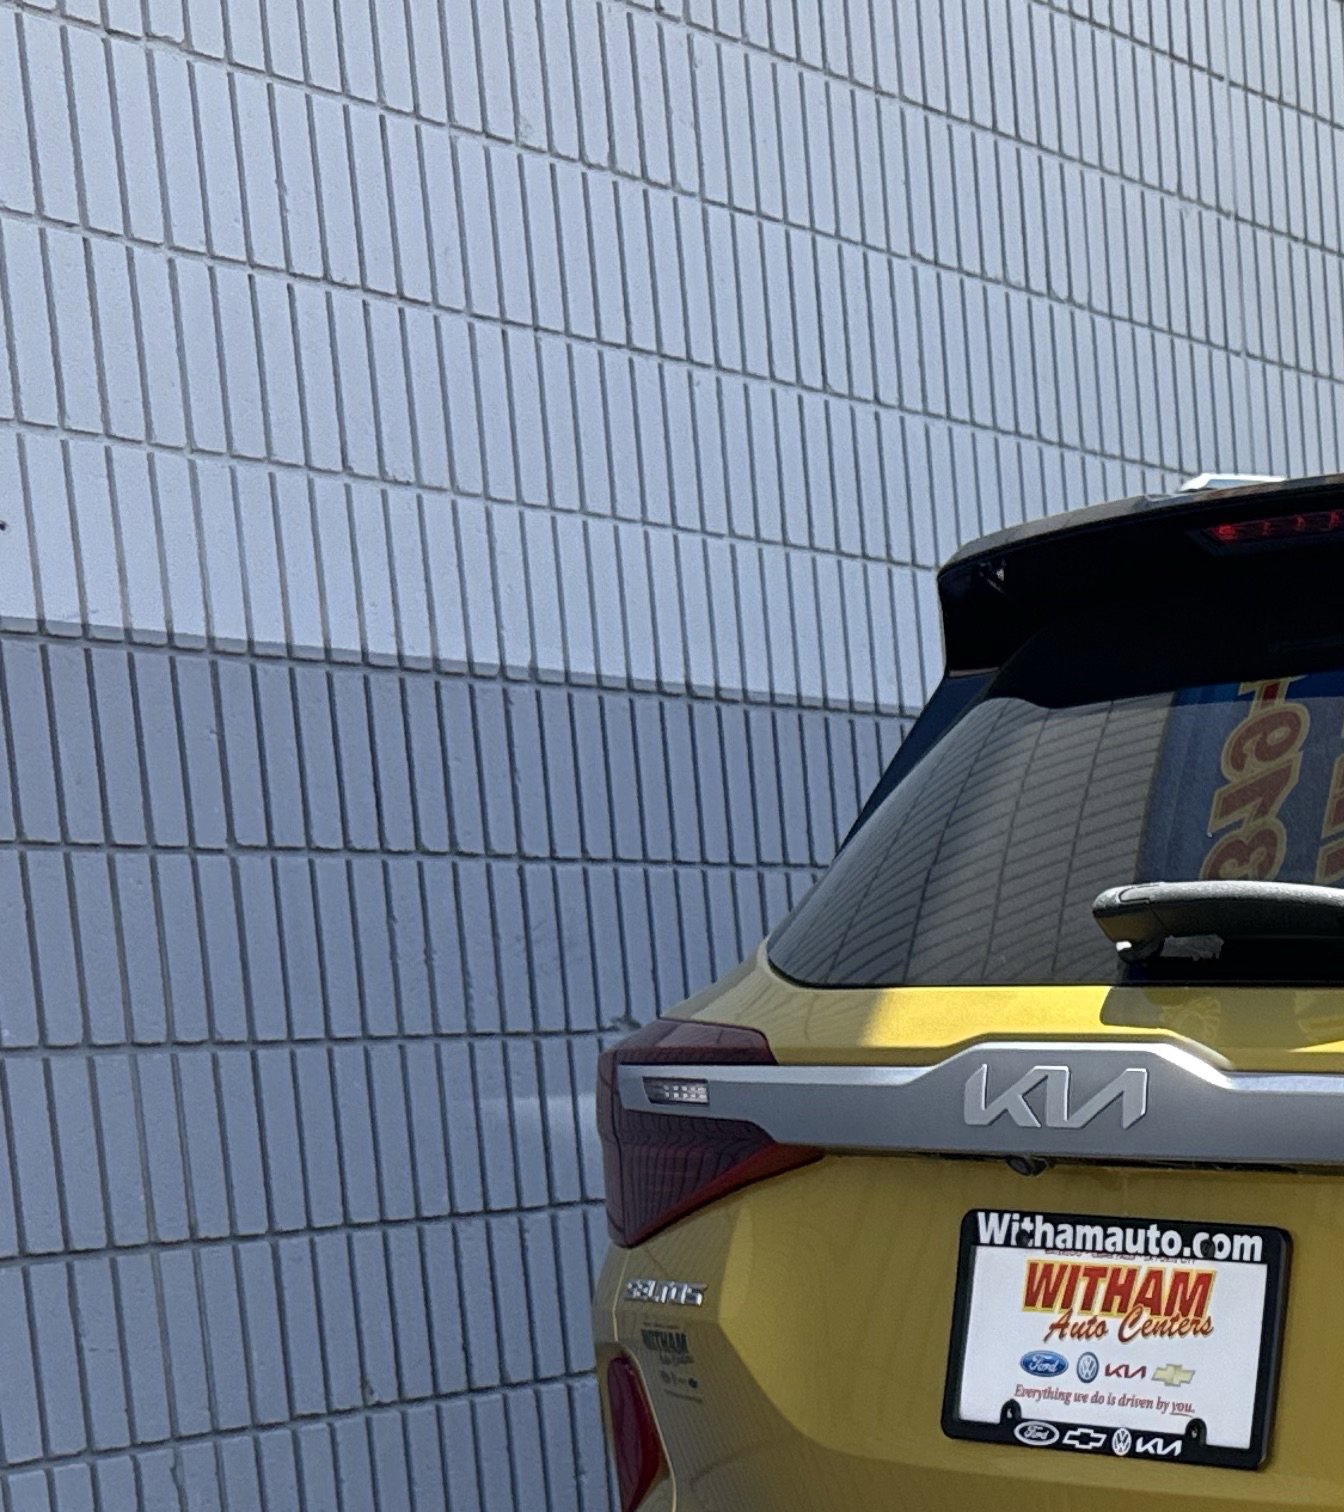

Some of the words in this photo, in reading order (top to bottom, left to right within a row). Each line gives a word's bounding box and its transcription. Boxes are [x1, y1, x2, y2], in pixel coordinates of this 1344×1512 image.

[964, 1063, 1148, 1130] KIA
[977, 1211, 1264, 1262] Withamauto.com
[1022, 1258, 1217, 1320] WITHAM
[1043, 1308, 1109, 1343] Auto
[1117, 1305, 1215, 1343] Centers
[1025, 1354, 1062, 1375] Ford
[1104, 1362, 1147, 1379] KIA
[1014, 1383, 1071, 1406] Everything
[1073, 1391, 1088, 1404] we
[1090, 1391, 1105, 1405] do
[1106, 1393, 1116, 1406] is
[1117, 1393, 1154, 1410] driven
[1155, 1396, 1170, 1414] by
[1136, 1437, 1182, 1457] KIA
